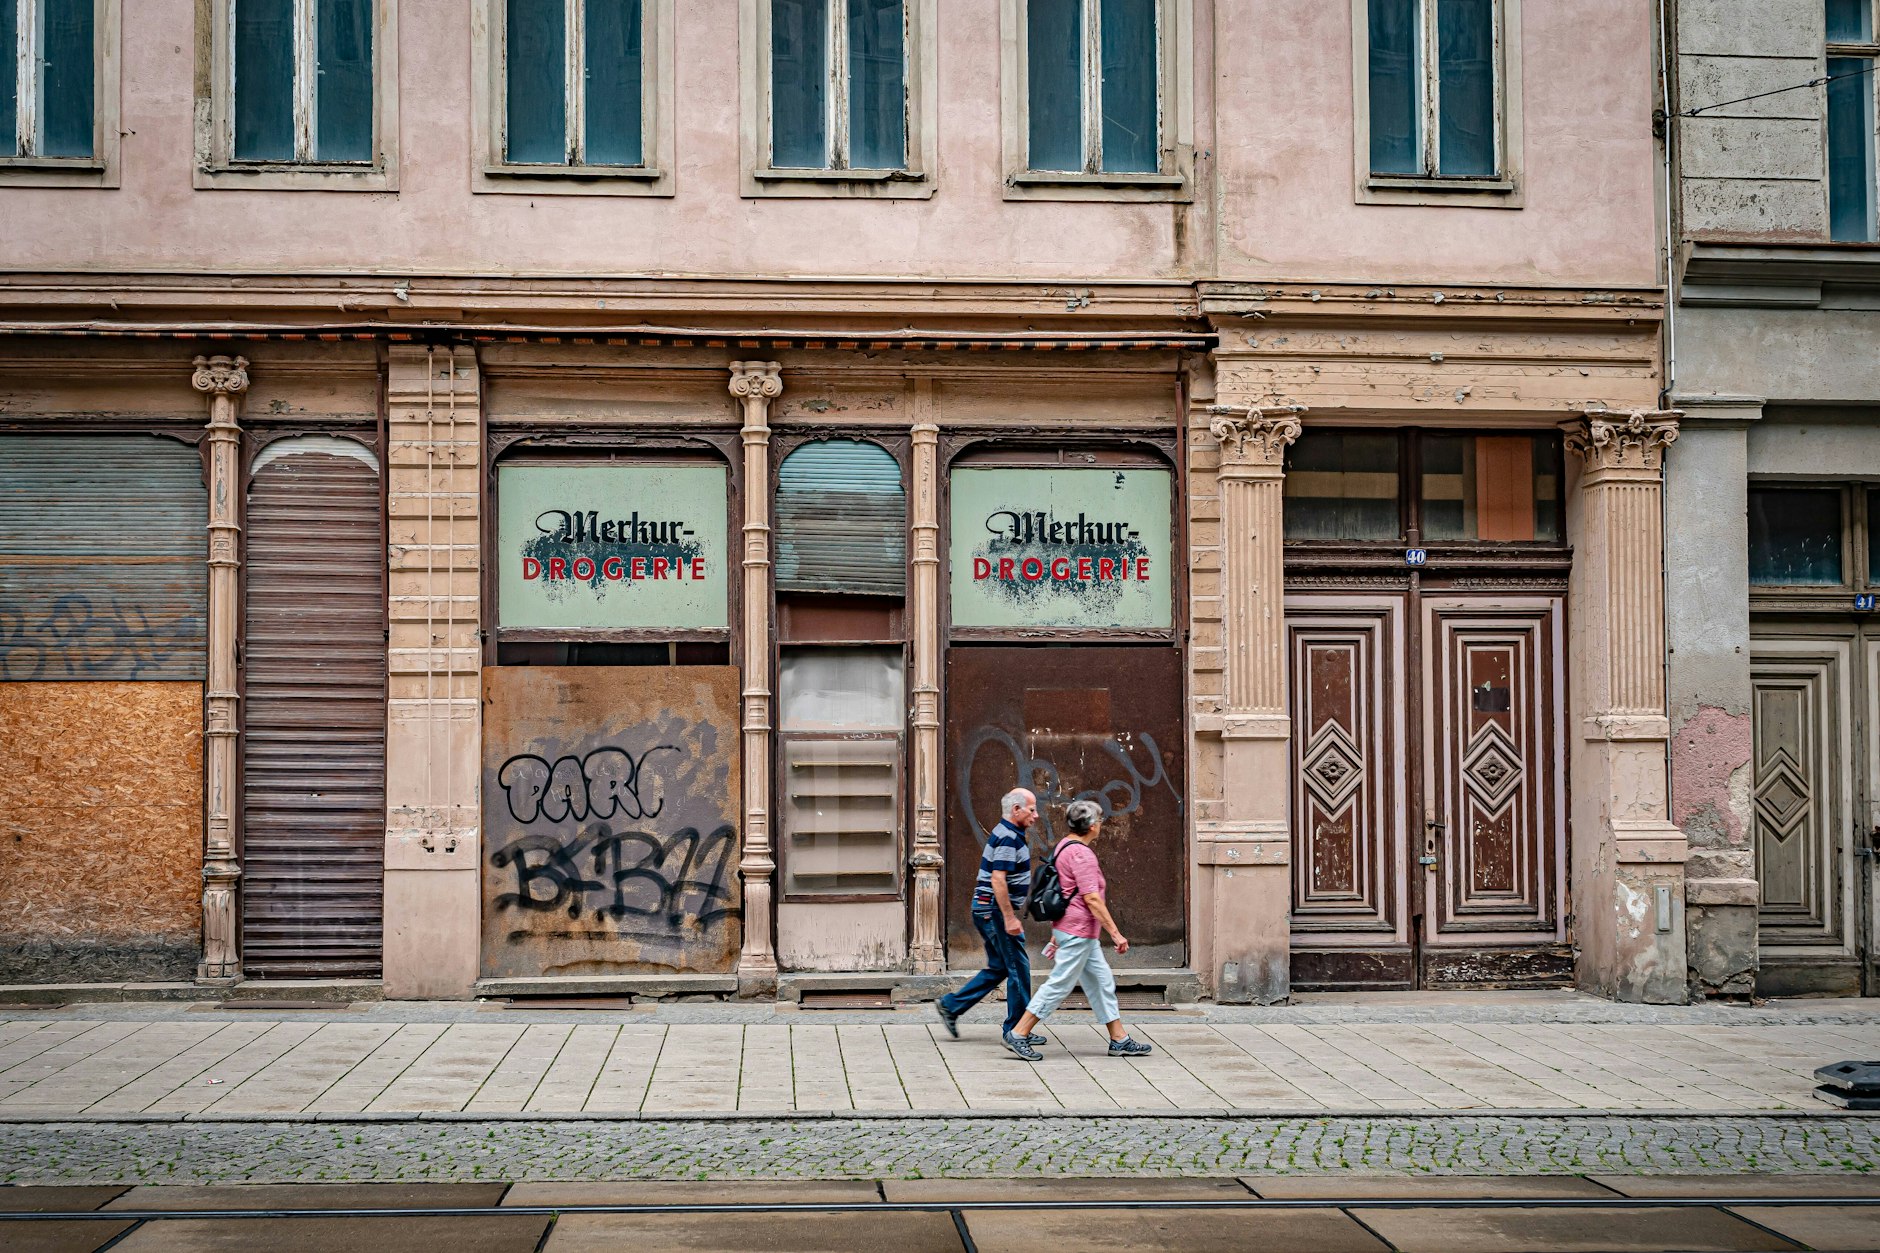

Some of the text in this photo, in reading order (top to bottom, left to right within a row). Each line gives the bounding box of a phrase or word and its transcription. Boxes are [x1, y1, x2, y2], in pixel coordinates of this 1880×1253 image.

[535, 509, 695, 545] Merkur-
[985, 510, 1139, 545] Merkur-
[523, 557, 705, 581] DROGERIE
[973, 557, 1150, 581] DROGERIE
[1407, 551, 1425, 564] 40
[1857, 595, 1873, 608] 41
